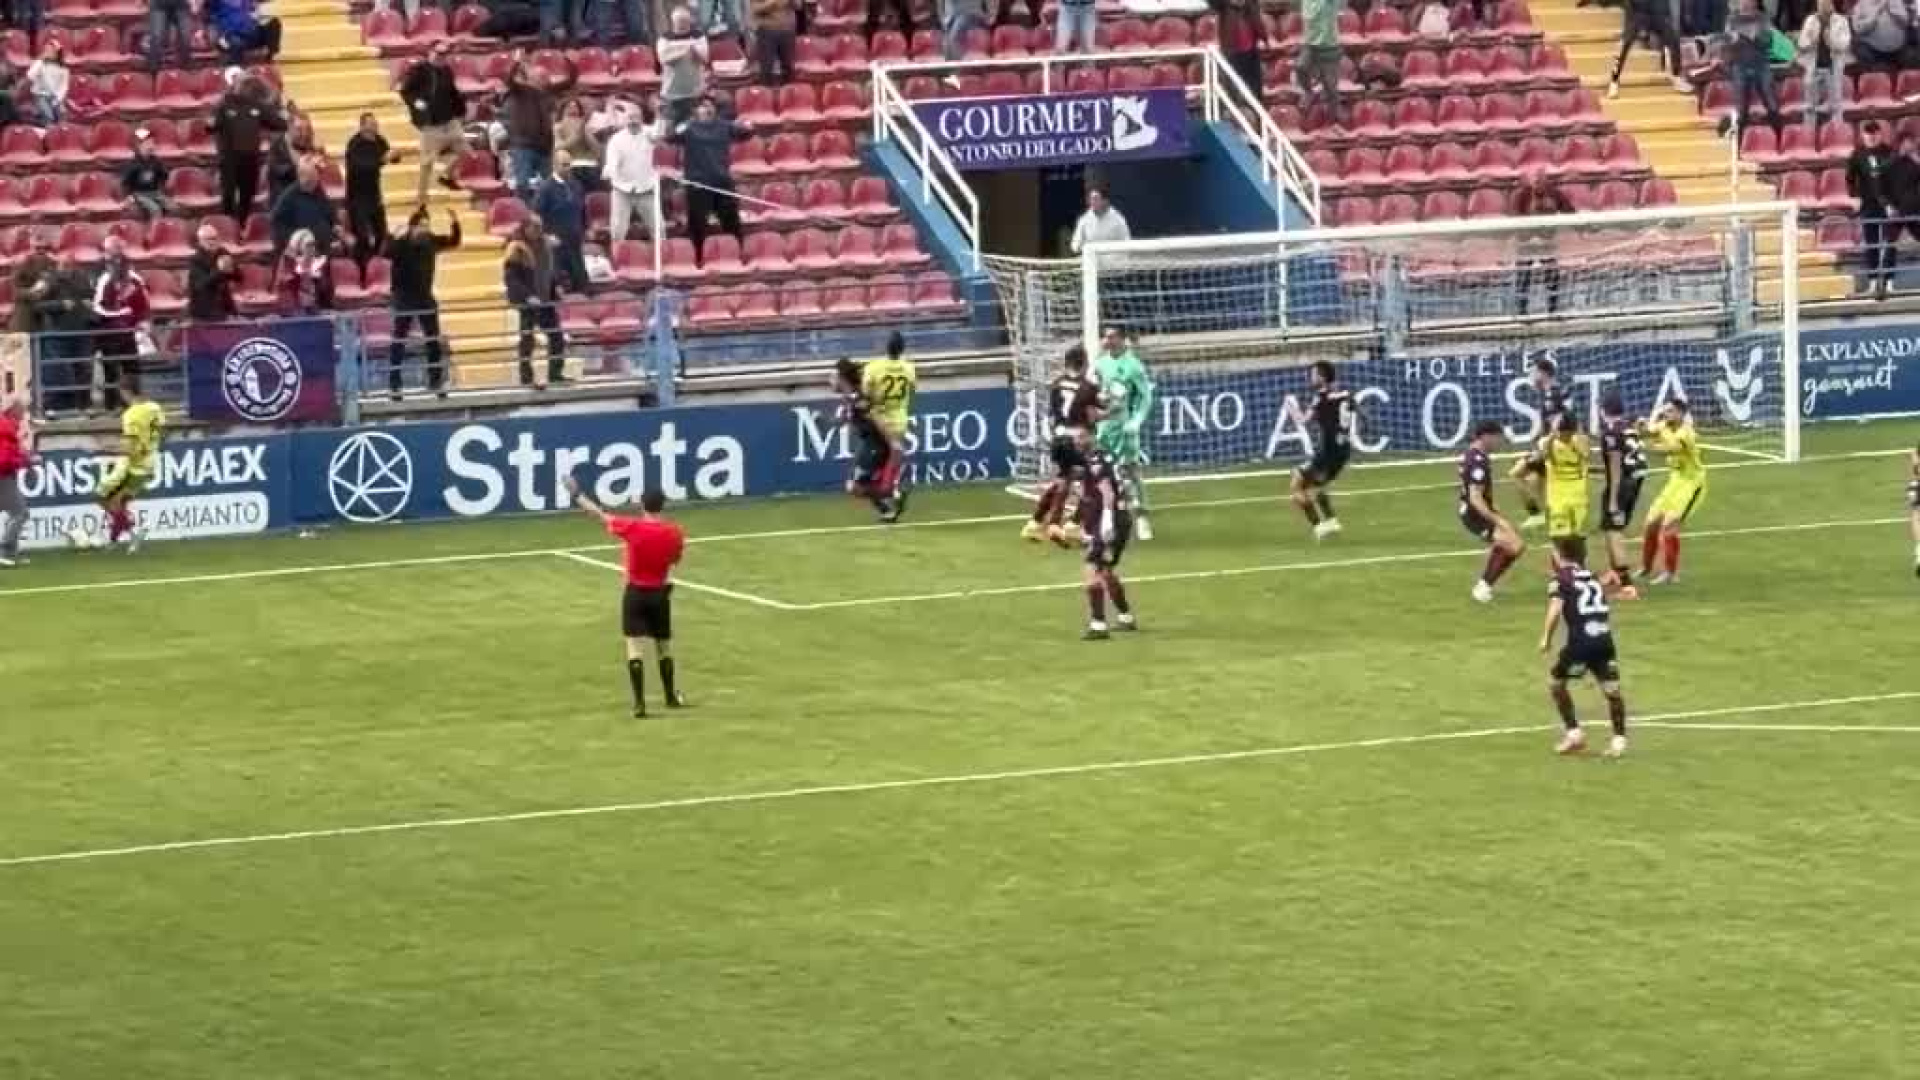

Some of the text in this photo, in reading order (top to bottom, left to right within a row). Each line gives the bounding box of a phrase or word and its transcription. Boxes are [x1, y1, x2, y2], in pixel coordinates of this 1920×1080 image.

[938, 98, 1109, 141] GOURMET
[1025, 135, 1111, 159] DELGADO
[1405, 349, 1558, 382] HOTELES
[882, 374, 908, 400] 23
[1060, 389, 1075, 418] 7
[789, 404, 987, 463] MSEO
[1160, 391, 1244, 437] INO
[1265, 366, 1690, 459] ACOSTA
[17, 444, 266, 498] ONSTUMAEX
[443, 421, 745, 516] Strata
[157, 500, 260, 528] AMIANTO
[1574, 580, 1609, 615] 22
